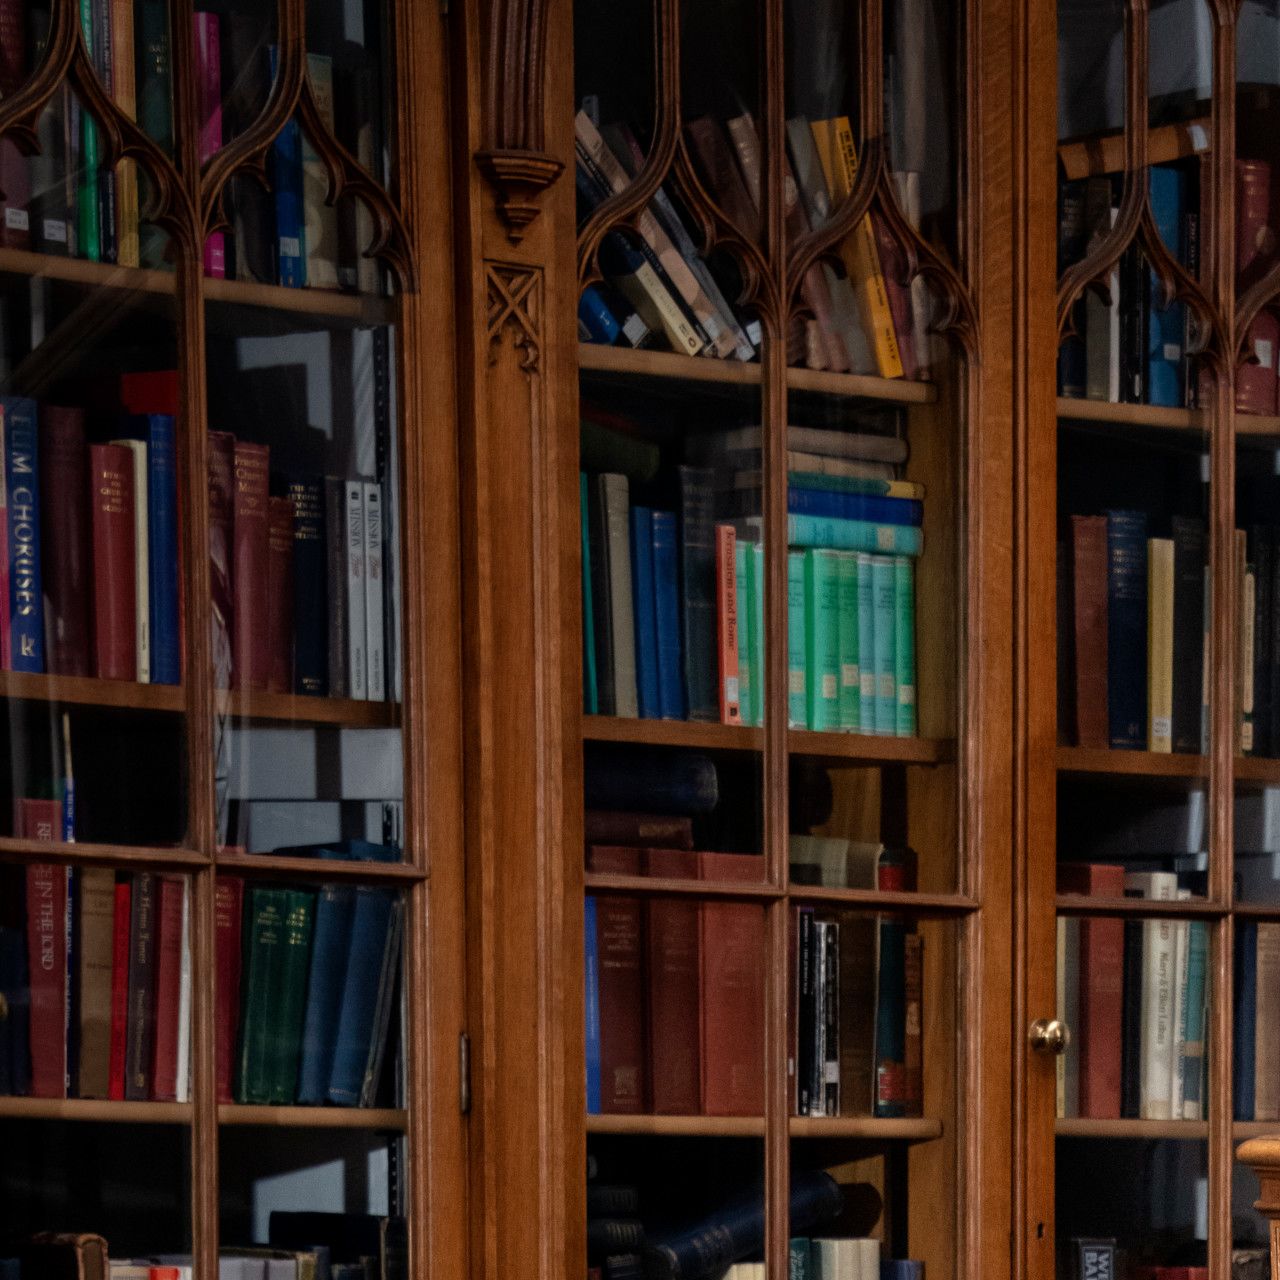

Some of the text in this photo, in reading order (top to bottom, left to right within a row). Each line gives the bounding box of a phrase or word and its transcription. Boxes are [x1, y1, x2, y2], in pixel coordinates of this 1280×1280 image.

[351, 507, 361, 548] MISSION
[369, 509, 380, 550] MISSION
[14, 486, 37, 617] CHORUSES
[726, 531, 737, 650] Jerusalem and Rome
[41, 901, 54, 933] THE
[41, 934, 54, 971] LORD
